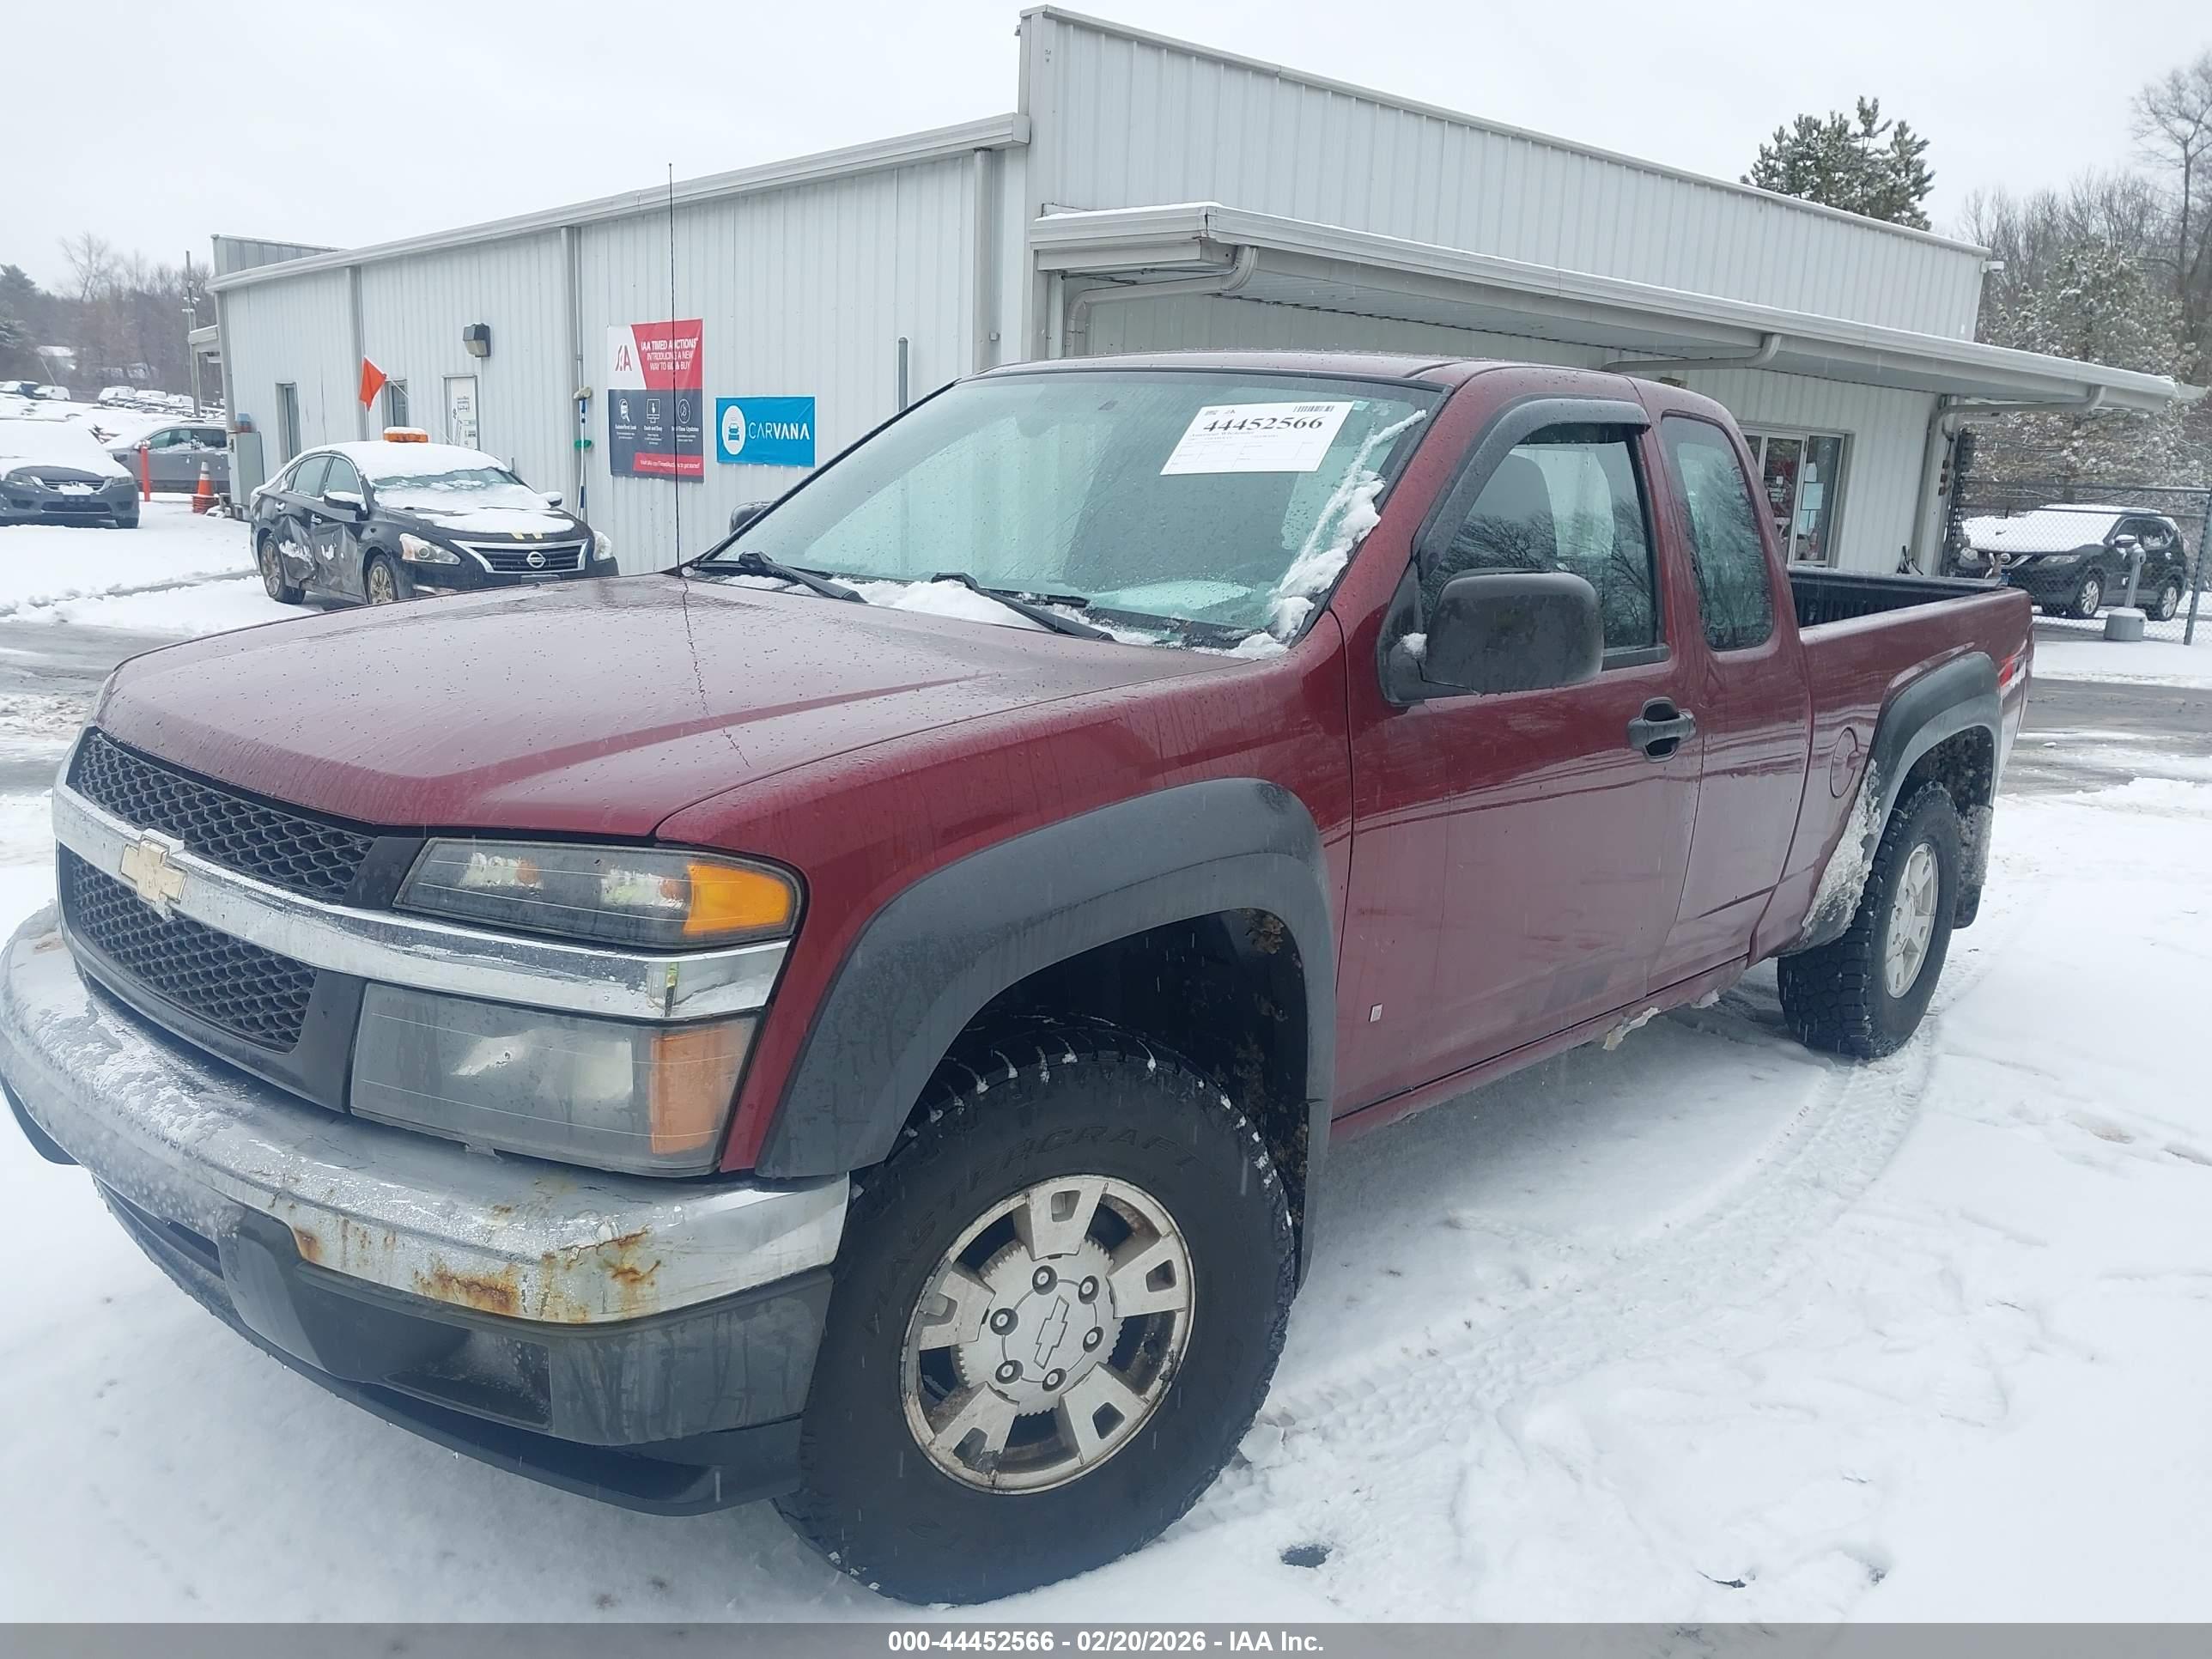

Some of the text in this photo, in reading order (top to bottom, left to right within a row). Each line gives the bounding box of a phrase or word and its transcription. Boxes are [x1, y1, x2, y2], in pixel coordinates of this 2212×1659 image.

[641, 341, 651, 351] IAA
[651, 340, 667, 350] TIMED
[660, 362, 666, 370] TO
[748, 422, 810, 441] CARVANA
[1203, 416, 1326, 433] 44452566
